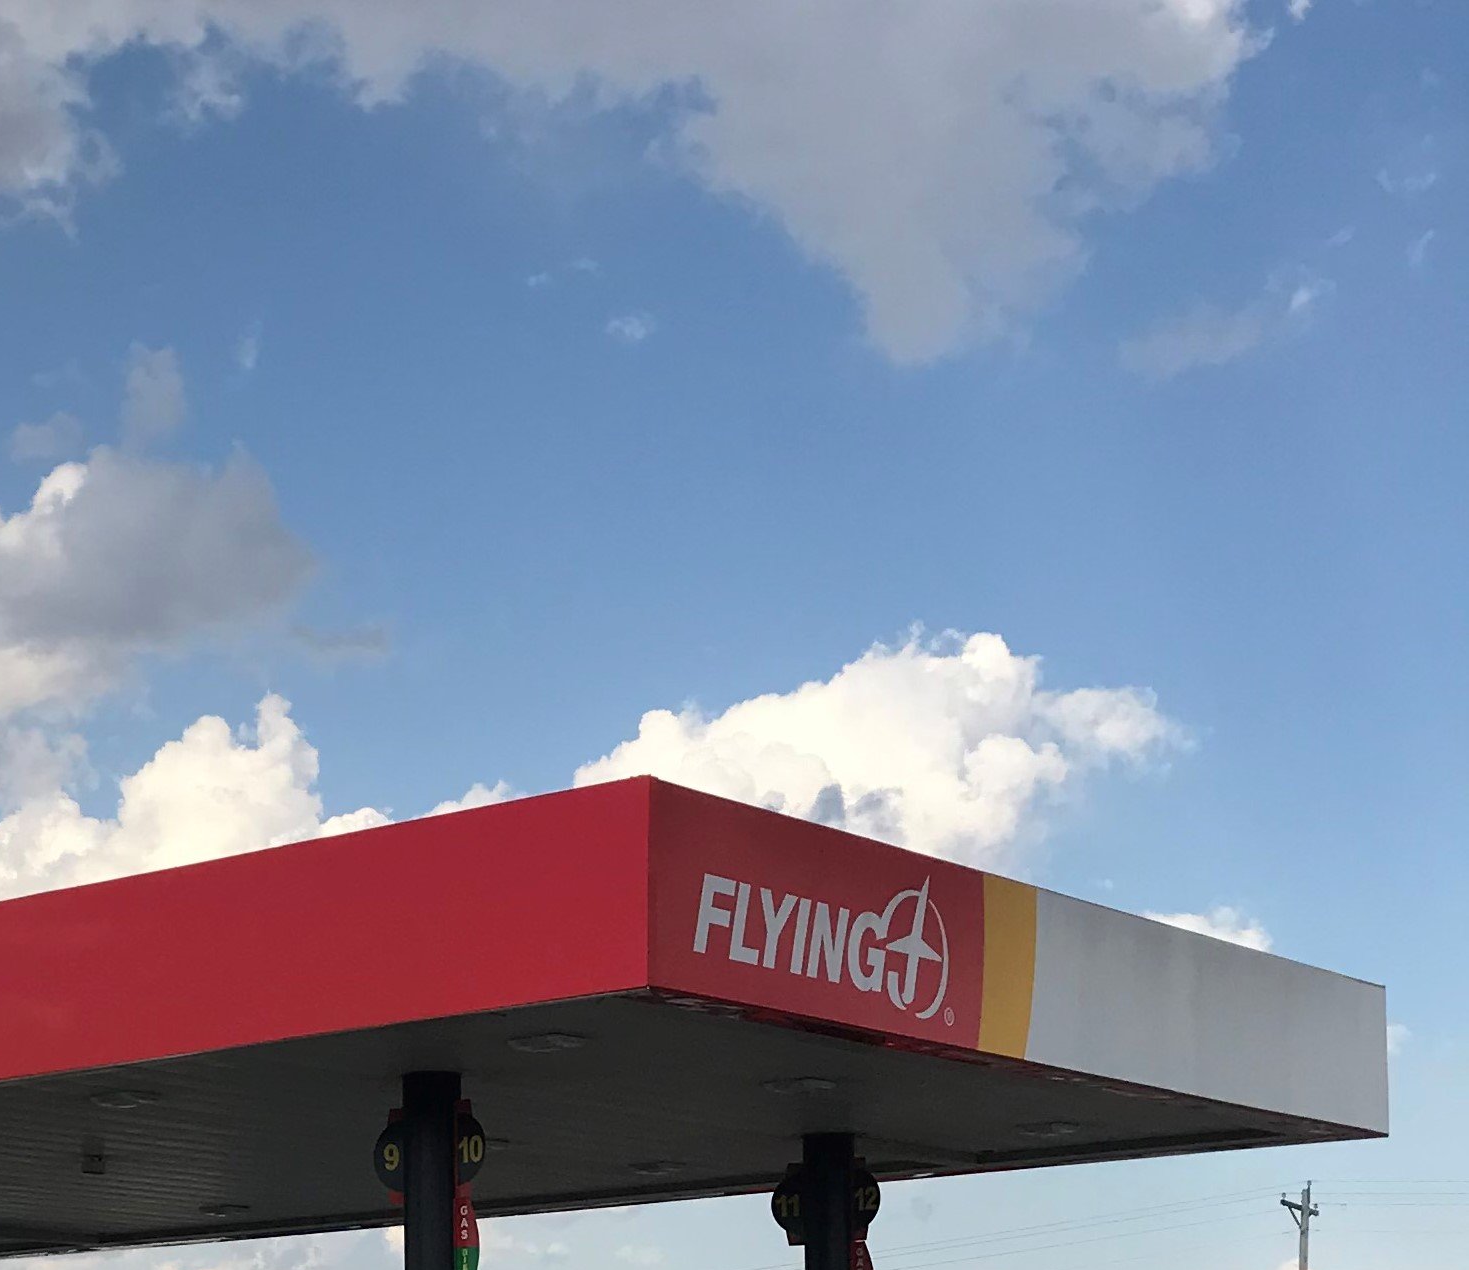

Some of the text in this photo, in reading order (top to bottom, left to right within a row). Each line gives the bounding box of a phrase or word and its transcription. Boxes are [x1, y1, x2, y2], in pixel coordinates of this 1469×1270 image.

[383, 1143, 399, 1171] 9
[458, 1134, 484, 1164] 10
[854, 1186, 877, 1211] 12
[459, 1205, 468, 1240] GAS
